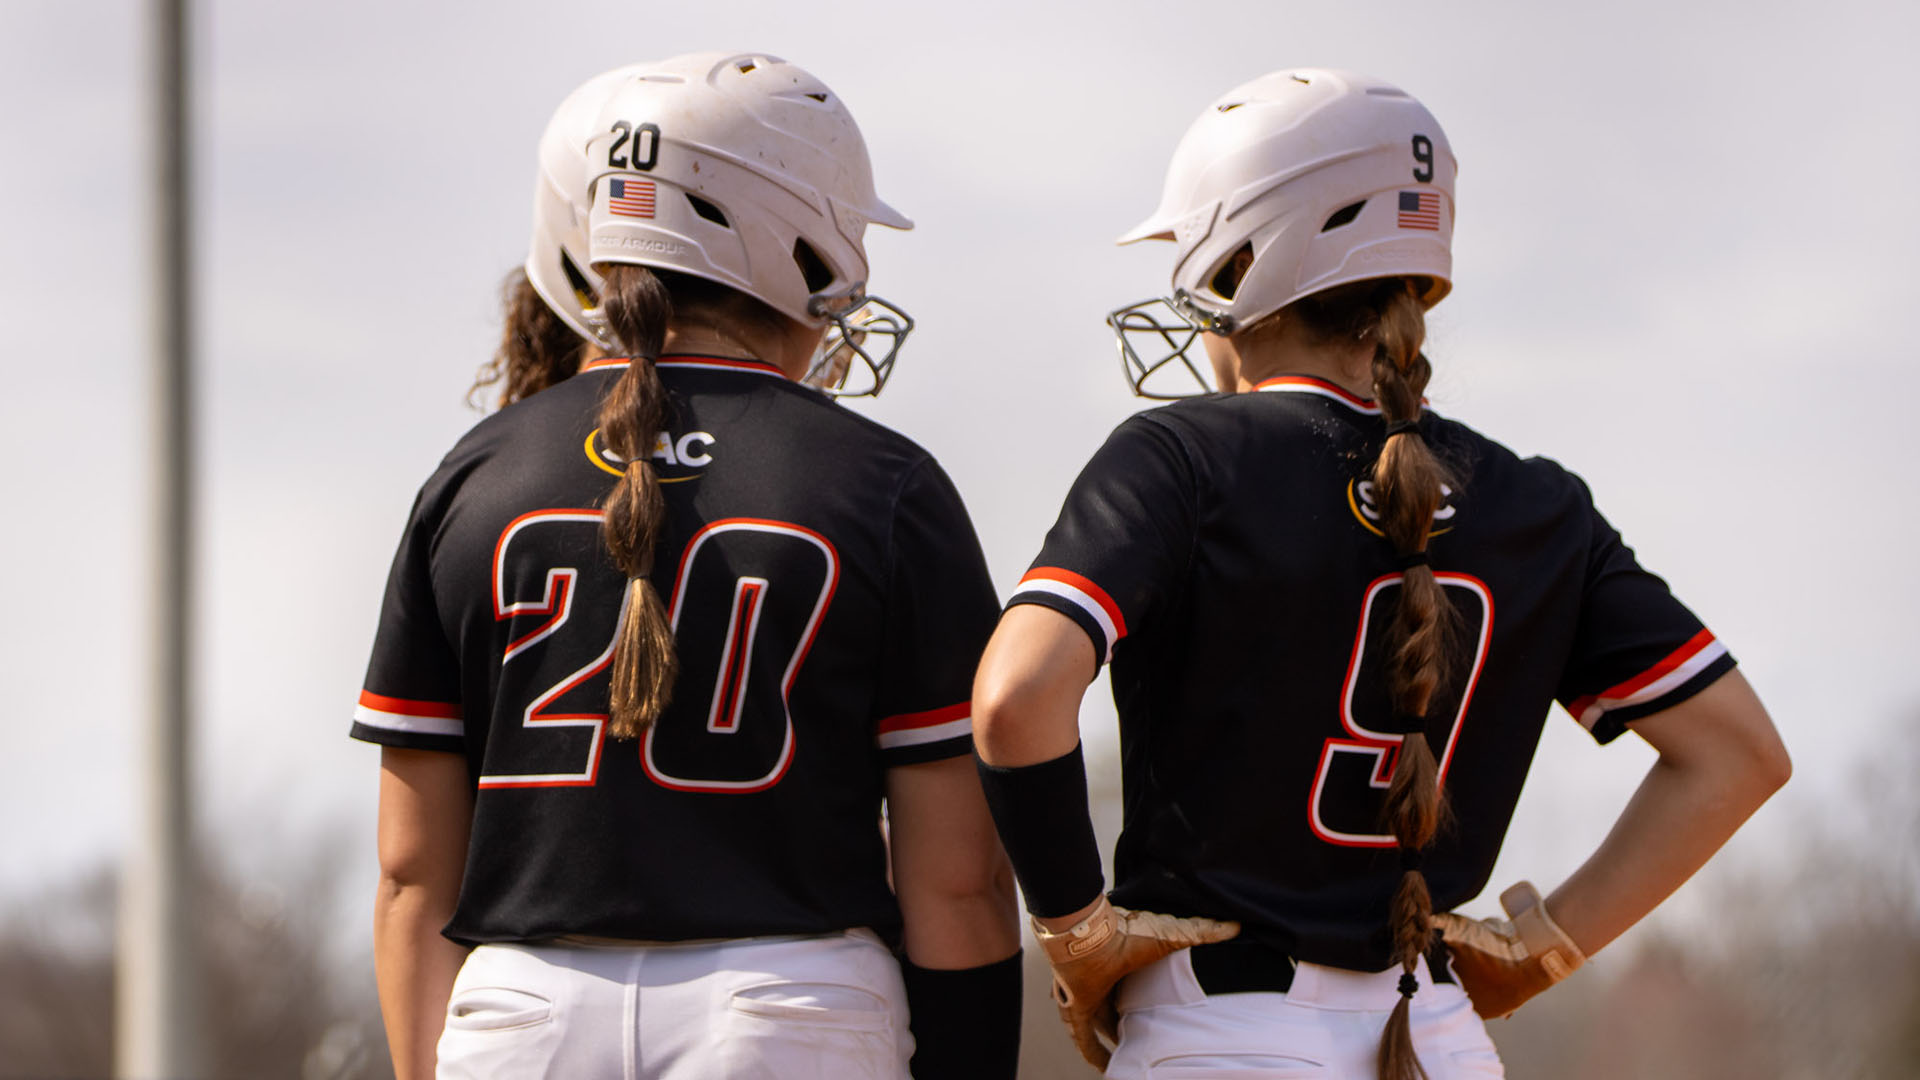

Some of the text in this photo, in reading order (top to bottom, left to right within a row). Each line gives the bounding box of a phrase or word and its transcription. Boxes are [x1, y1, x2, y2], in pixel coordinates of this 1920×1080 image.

[609, 120, 660, 172] 20
[1412, 134, 1433, 183] 9
[479, 508, 840, 794] 20
[1307, 571, 1495, 848] 9
